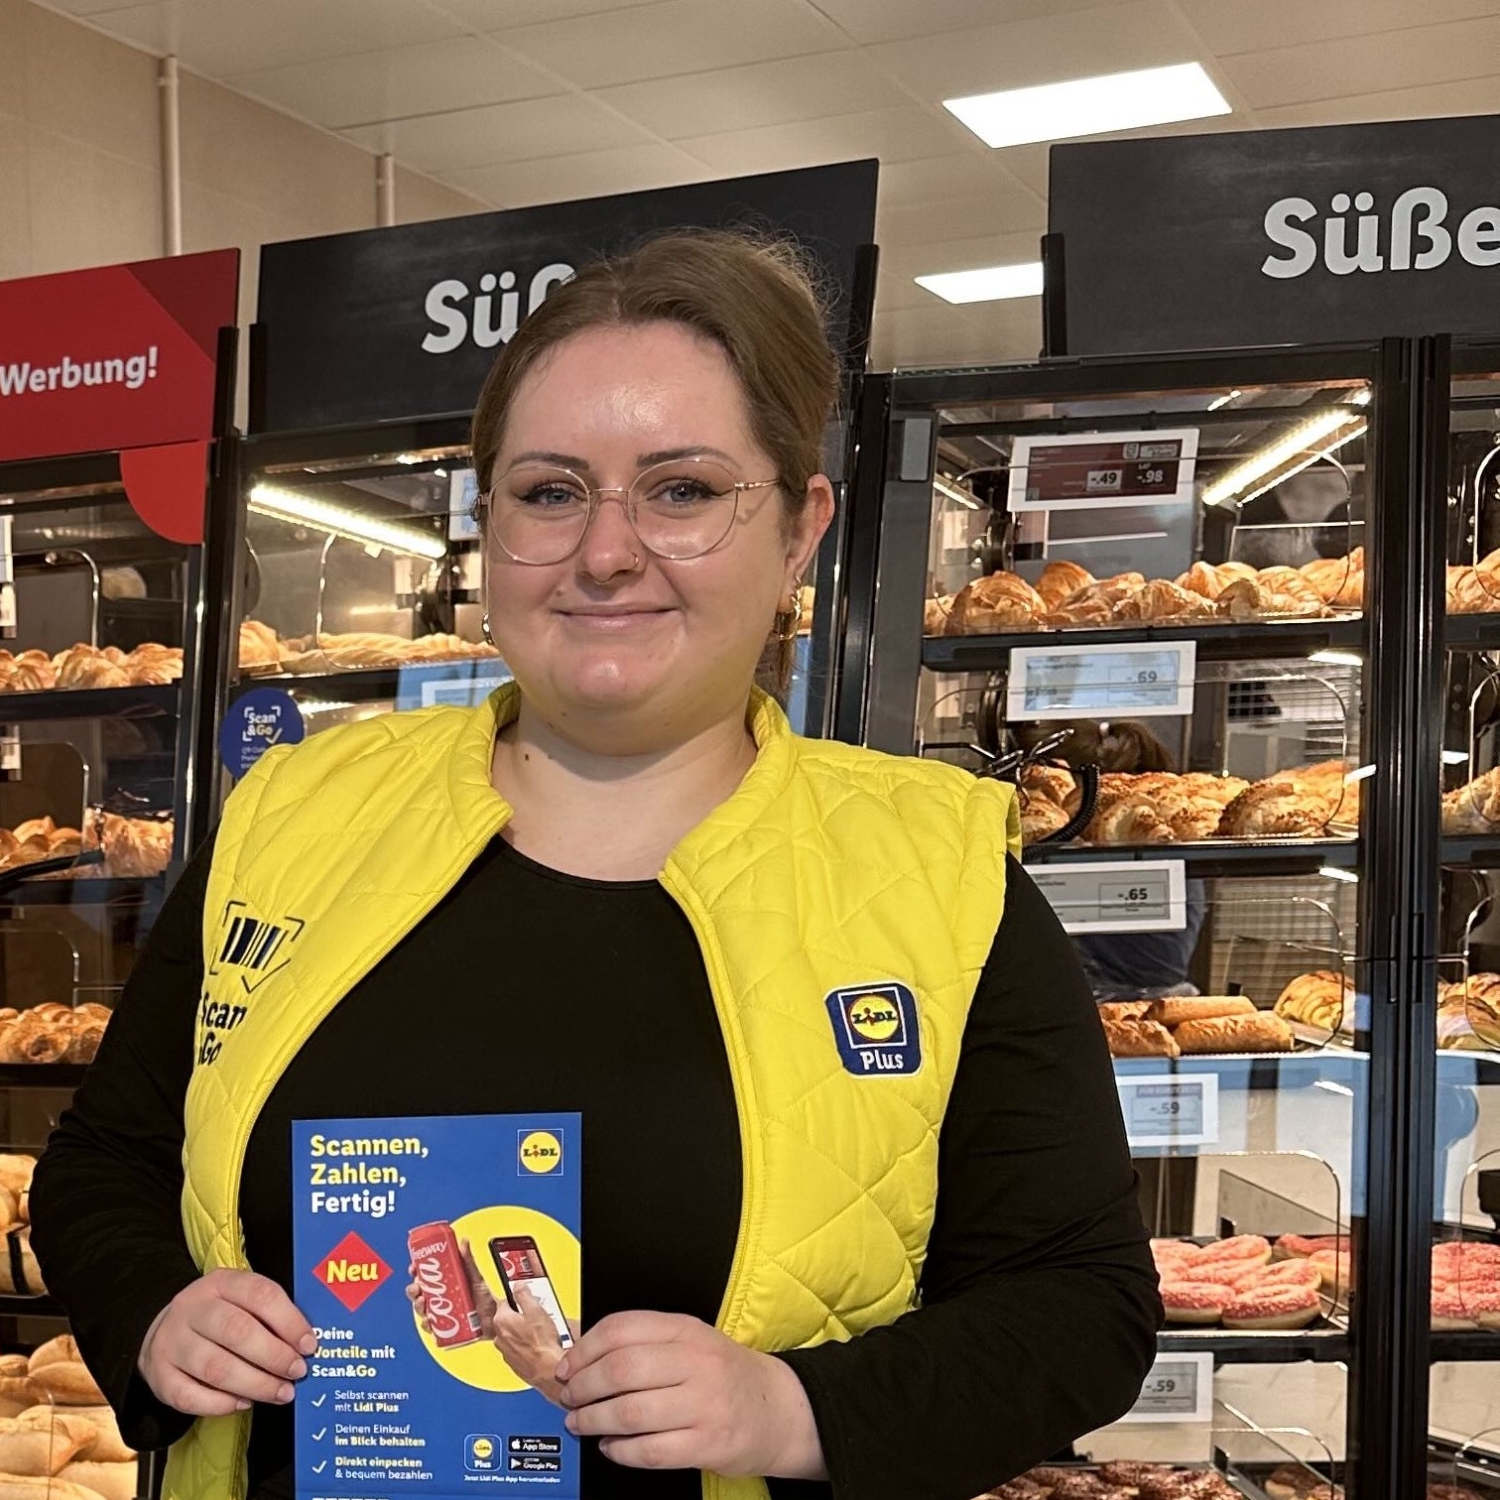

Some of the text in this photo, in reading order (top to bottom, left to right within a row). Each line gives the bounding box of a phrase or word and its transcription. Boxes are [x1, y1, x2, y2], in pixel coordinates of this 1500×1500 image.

[1261, 186, 1500, 279] Süße
[247, 711, 276, 724] Scan
[247, 724, 273, 736] &Go
[1117, 888, 1149, 901] -.65
[860, 1049, 904, 1070] Plus
[310, 1134, 429, 1158] Scannen,
[310, 1161, 407, 1188] Zahlen,
[311, 1188, 395, 1218] Fertig!
[326, 1259, 378, 1284] Neu
[419, 1257, 460, 1339] Cola
[312, 1327, 354, 1340] Deine
[371, 1345, 396, 1359] mit
[311, 1365, 377, 1377] Scan&Go
[334, 1390, 409, 1400] Selbst scannen
[334, 1402, 399, 1413] mit Lidl Plus
[335, 1423, 410, 1434] Deinen Einkauf
[335, 1436, 426, 1447] im Blick behalten
[334, 1456, 423, 1468] Direkt einpacken
[334, 1470, 433, 1480] & bequem bezahlen
